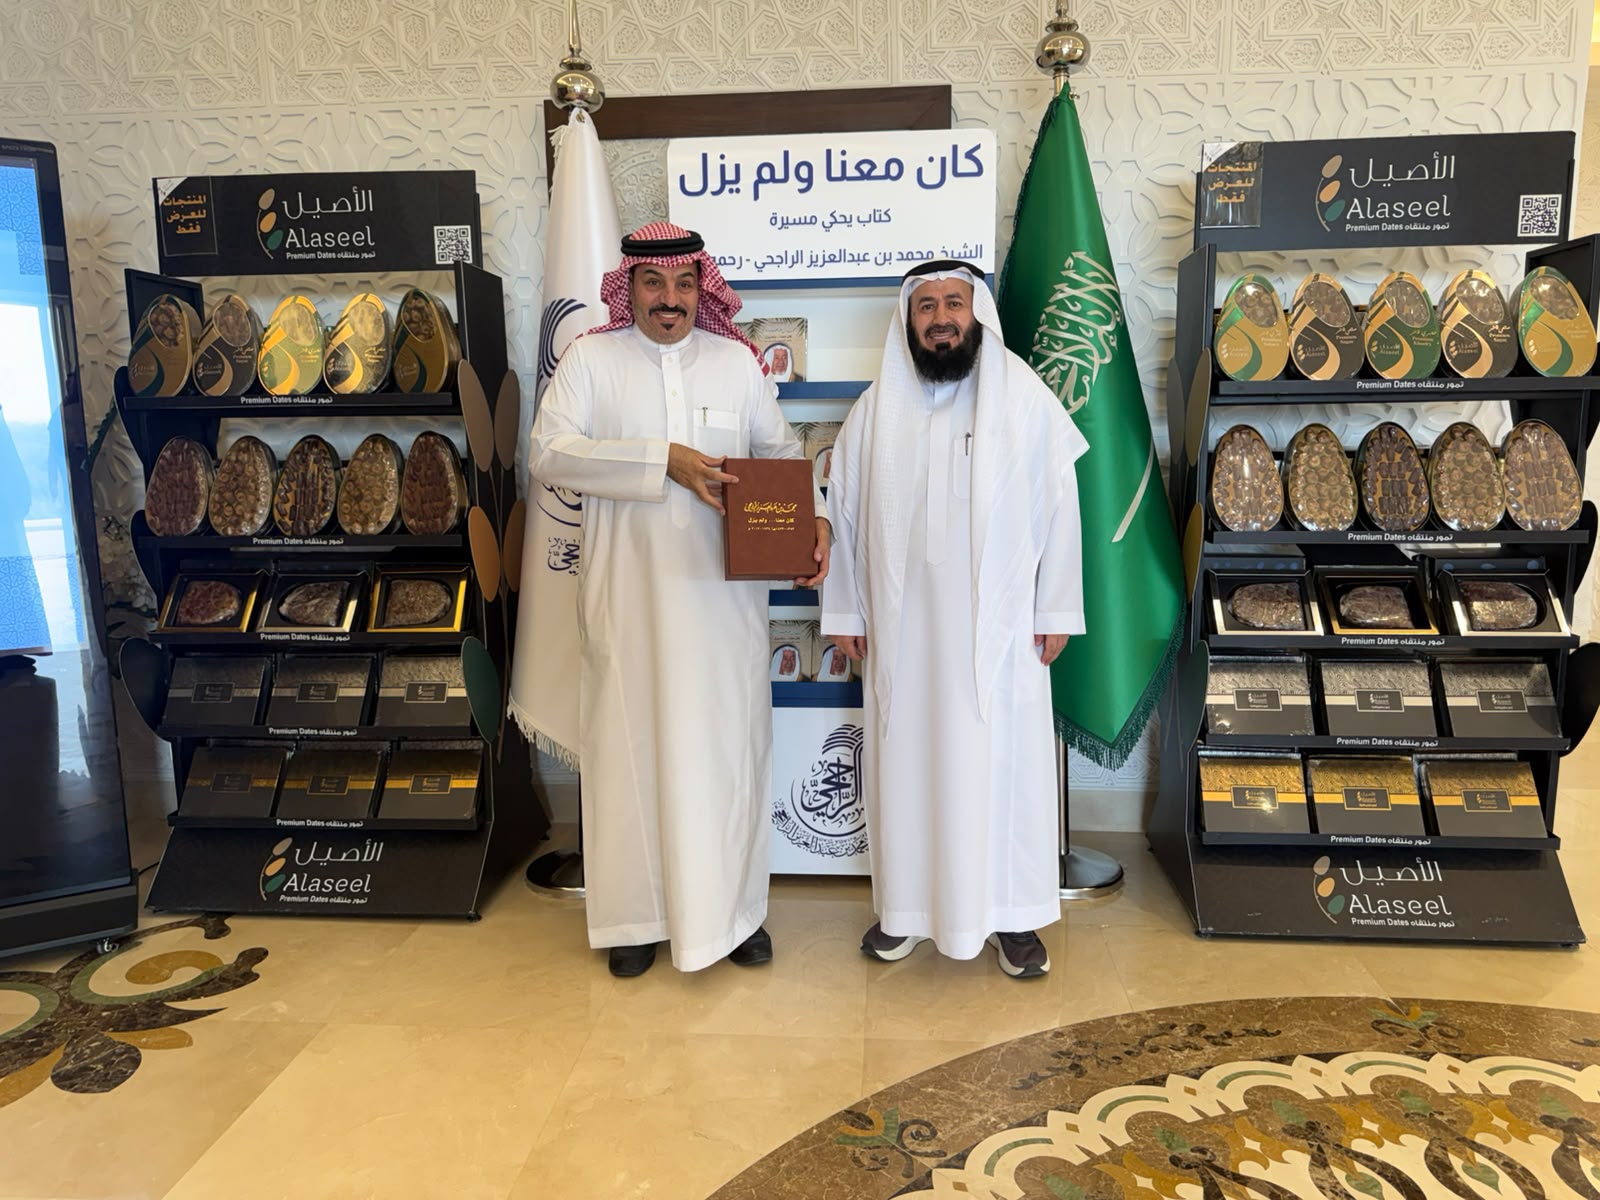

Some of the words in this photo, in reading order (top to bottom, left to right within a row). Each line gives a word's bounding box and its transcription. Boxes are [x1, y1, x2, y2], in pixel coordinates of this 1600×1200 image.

[679, 152, 741, 196] يزل
[825, 148, 904, 182] معنا
[916, 143, 984, 190] كان
[1208, 162, 1256, 175] المنتجات
[1349, 151, 1456, 188] الأصيل
[753, 150, 814, 201] ولم
[1208, 178, 1254, 190] للعرض
[163, 194, 206, 208] المنتجات
[282, 186, 374, 219] الأصيل
[1216, 190, 1245, 203] فقط
[166, 209, 206, 222] للعرض
[856, 208, 892, 226] كتاب
[1346, 195, 1451, 221] Alaseel
[176, 222, 200, 234] فقط
[770, 214, 818, 230] مسيرة
[821, 211, 853, 232] يحكي
[1432, 222, 1449, 231] تمور
[286, 226, 376, 248] Alaseel
[754, 250, 803, 272] الراجحي
[807, 249, 870, 269] عبدالعزيز
[874, 252, 892, 266] بن
[896, 250, 934, 260] محمد
[296, 838, 384, 866] الأصيل
[1340, 857, 1442, 886] الأصيل
[283, 873, 371, 892] Alaseel
[1350, 894, 1452, 915] Alaseel
